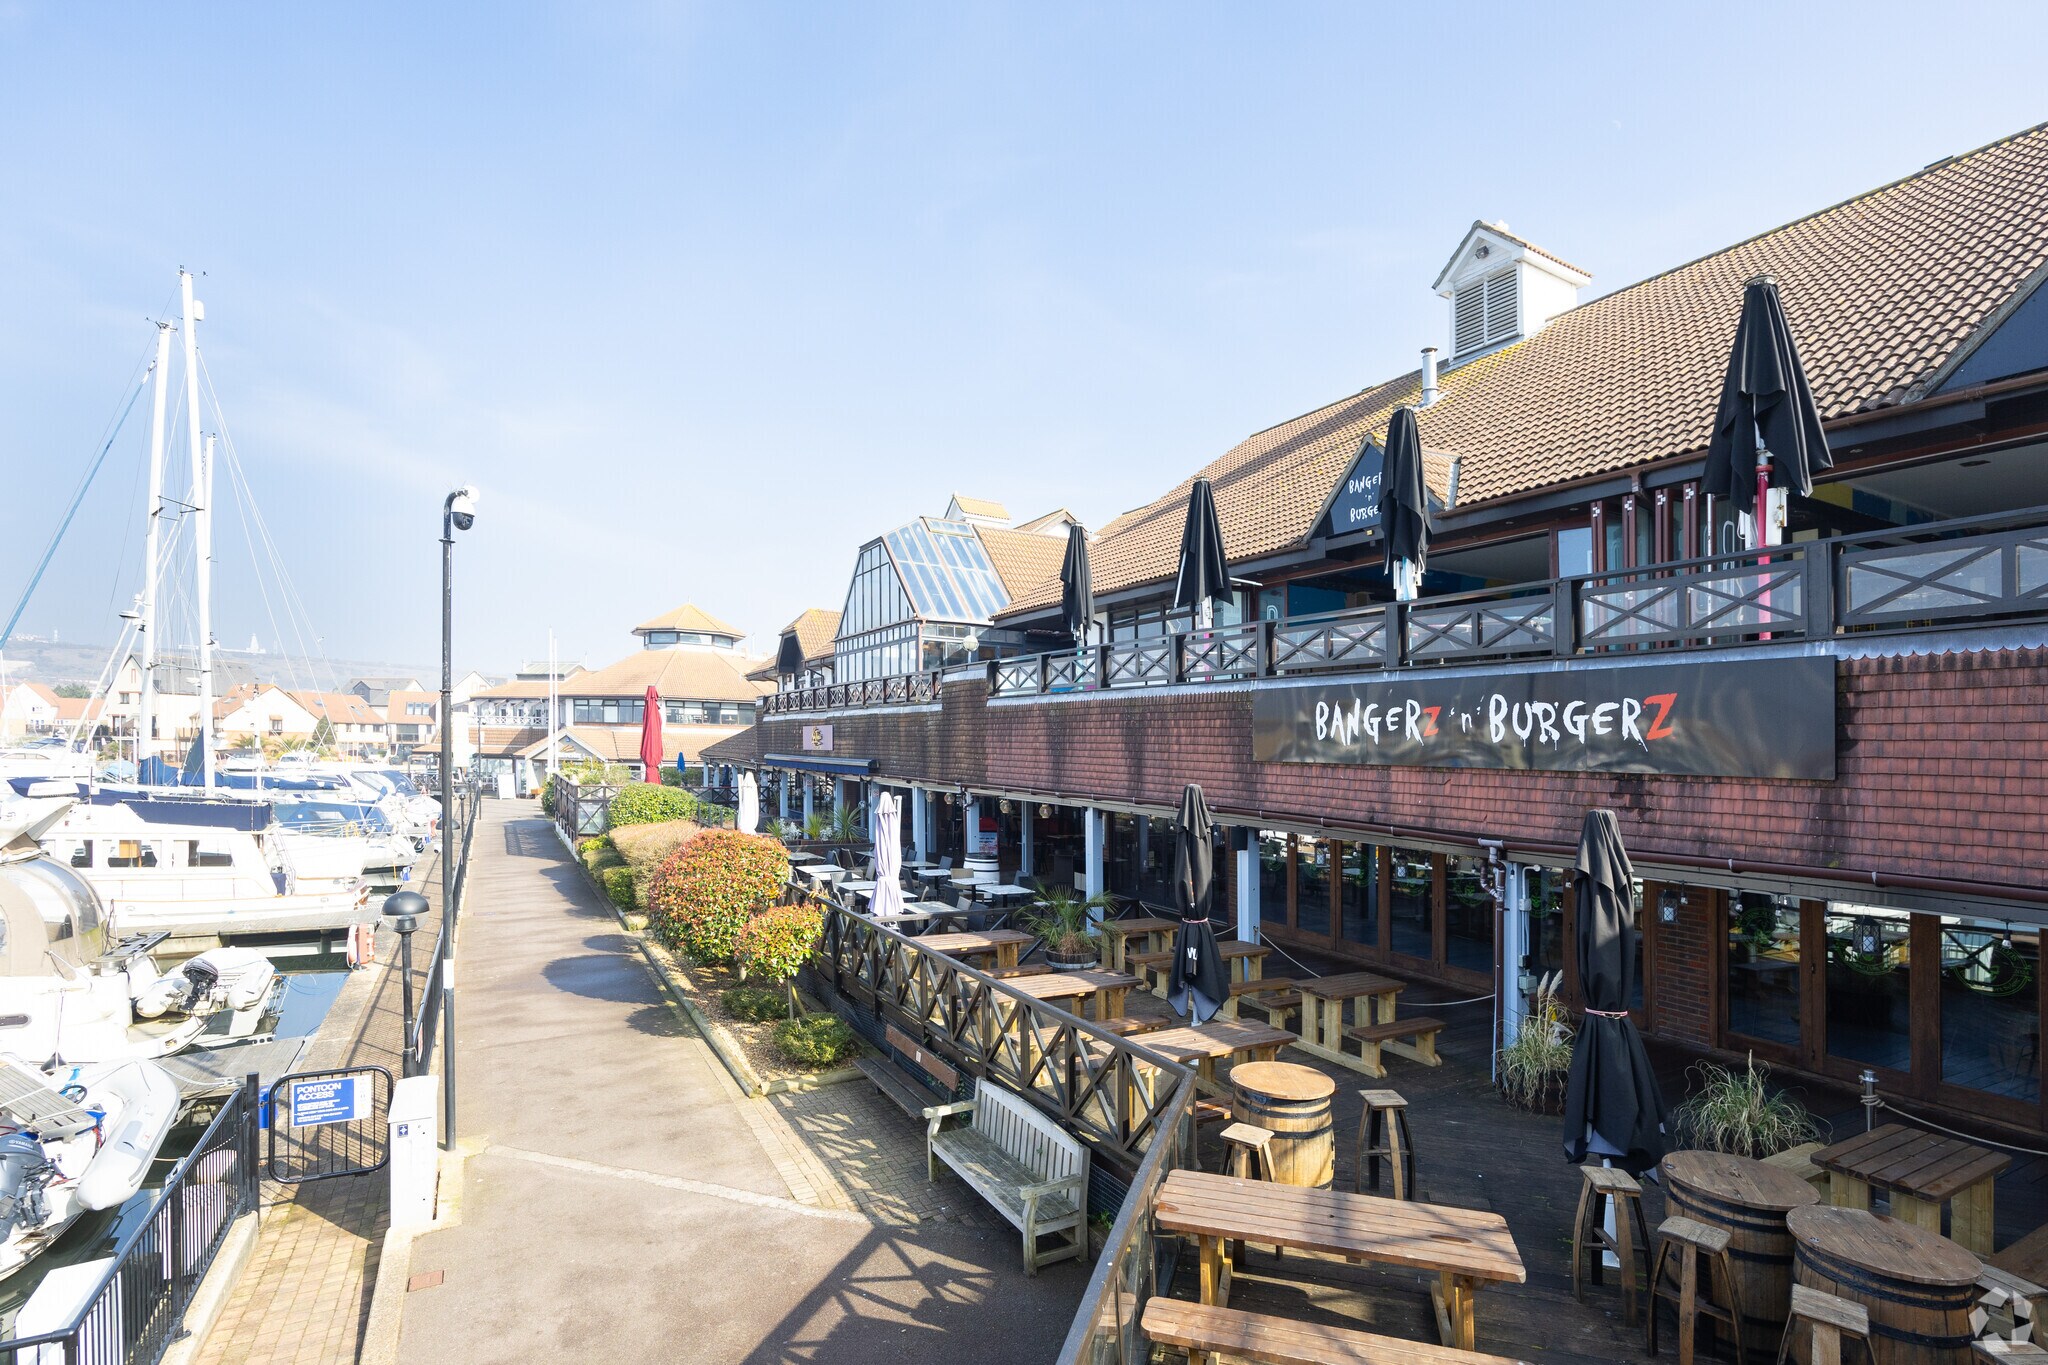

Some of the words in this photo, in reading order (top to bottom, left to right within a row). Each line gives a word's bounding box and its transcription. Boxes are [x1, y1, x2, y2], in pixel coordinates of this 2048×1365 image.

[1350, 505, 1382, 522] BURGE
[1315, 698, 1442, 747] BANGERZ
[1489, 692, 1678, 752] BURGERZ
[297, 1083, 341, 1094] PONTOON
[297, 1091, 335, 1101] ACCESS
